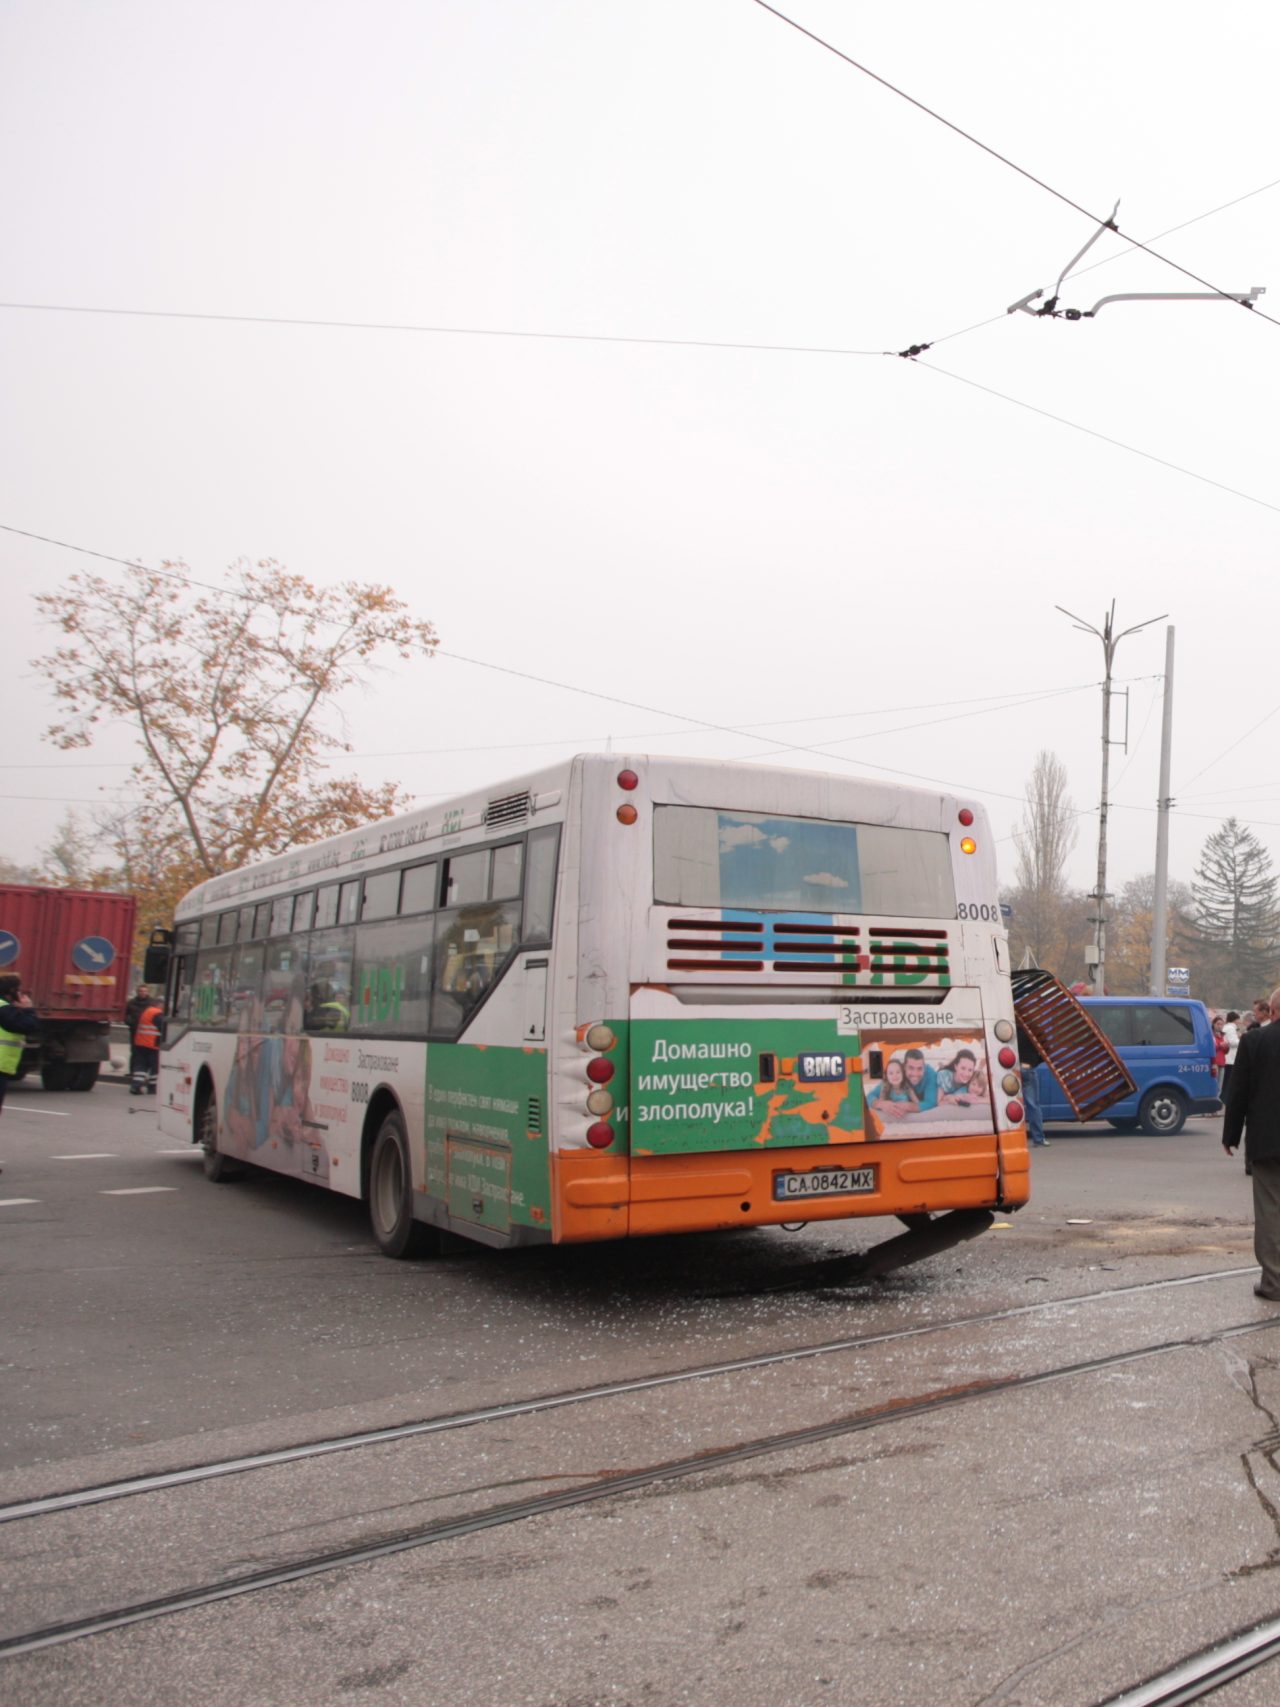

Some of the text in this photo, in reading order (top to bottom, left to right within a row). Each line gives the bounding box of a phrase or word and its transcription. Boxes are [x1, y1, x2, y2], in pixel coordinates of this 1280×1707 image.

[957, 902, 998, 922] 8008
[842, 1006, 954, 1030] Застраховане
[652, 1038, 752, 1063] Домашно
[803, 1055, 843, 1078] BMC
[638, 1071, 753, 1096] имущество
[616, 1097, 754, 1124] и злополука!
[811, 1173, 849, 1191] 0842
